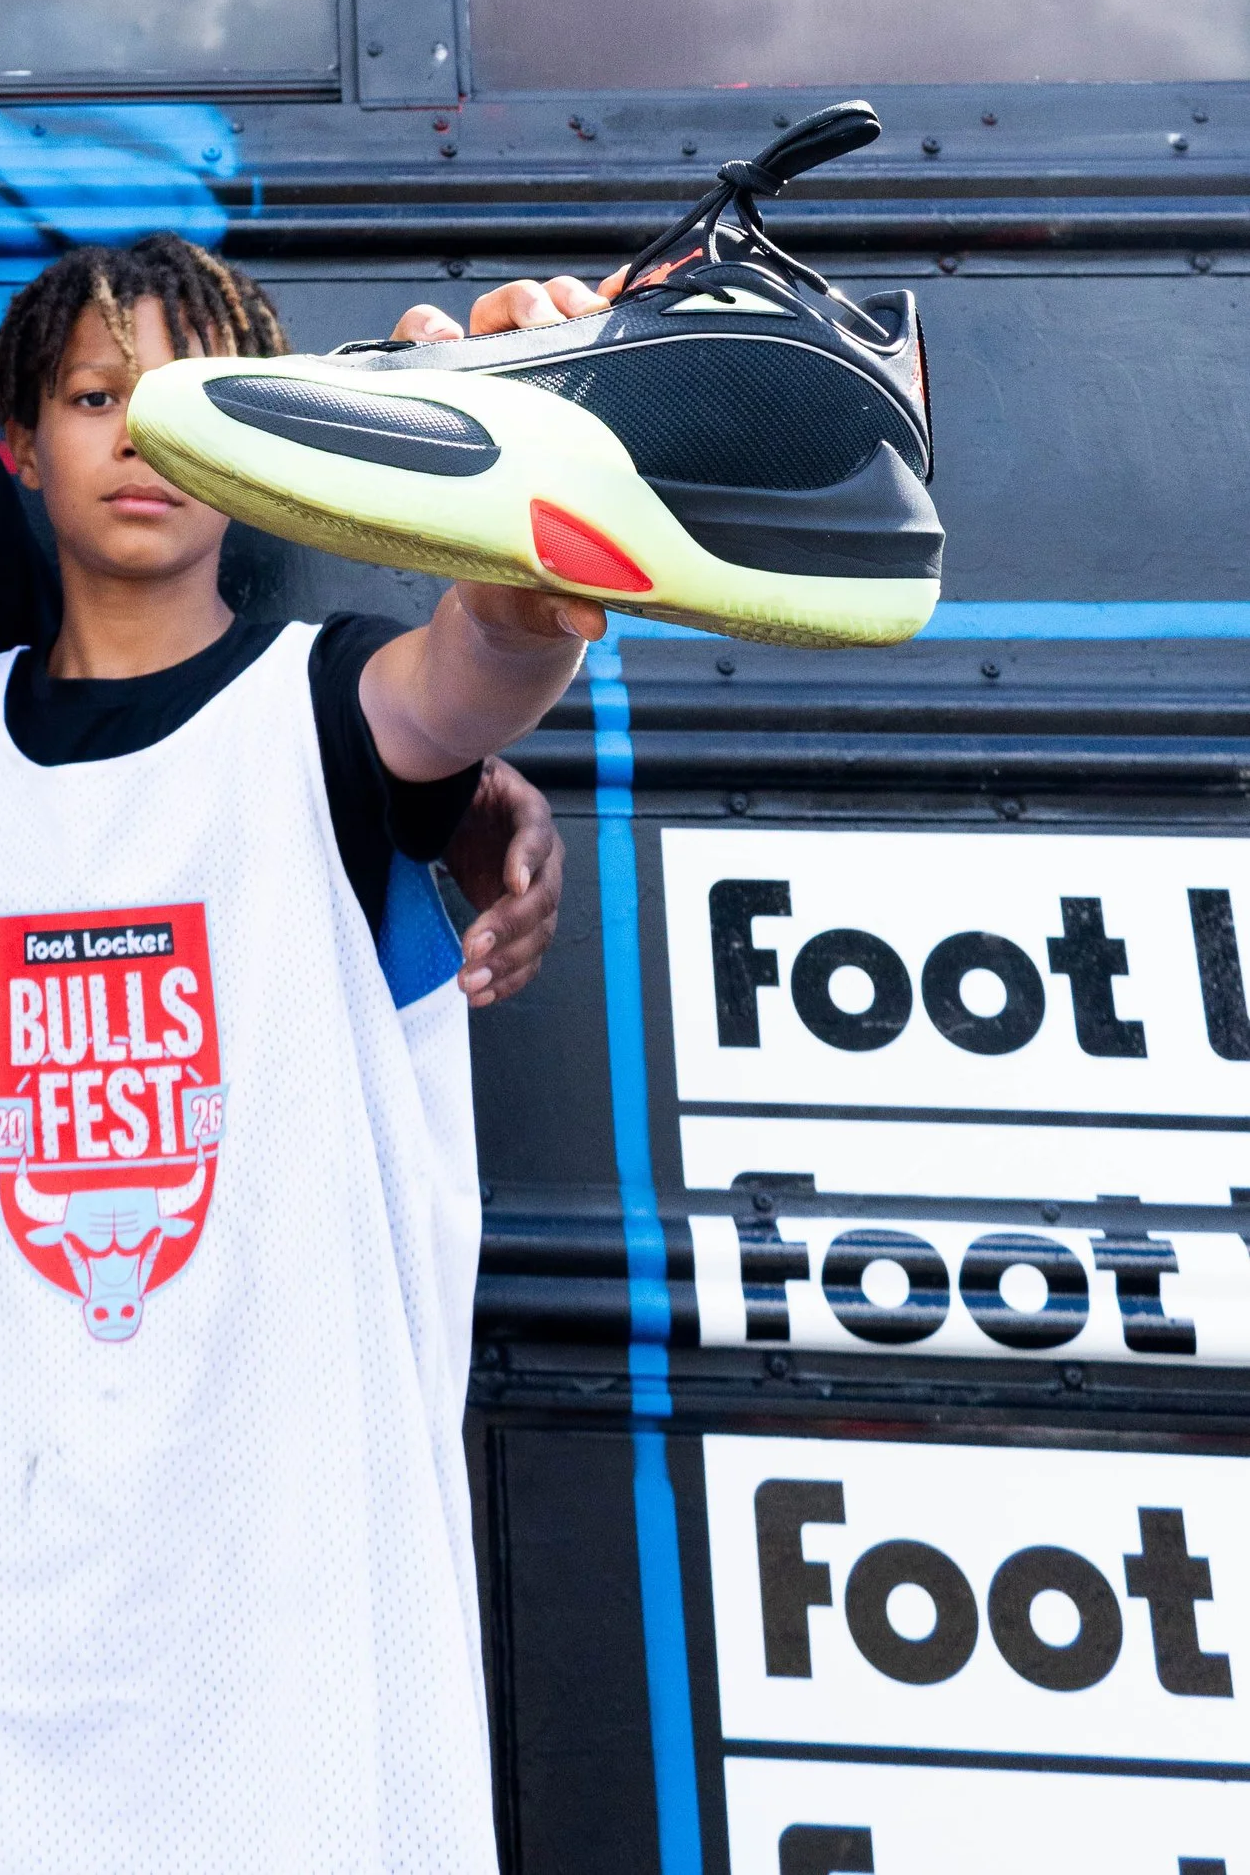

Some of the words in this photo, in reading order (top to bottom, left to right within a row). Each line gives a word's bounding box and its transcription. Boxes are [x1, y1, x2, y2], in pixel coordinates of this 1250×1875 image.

[26, 934, 76, 961] Foot
[82, 929, 169, 958] Locker
[708, 878, 1148, 1059] Foot
[9, 966, 204, 1067] BULLS
[38, 1065, 183, 1161] FEST
[190, 1093, 224, 1138] 26
[730, 1171, 1197, 1356] Foot
[753, 1477, 1235, 1699] Foot
